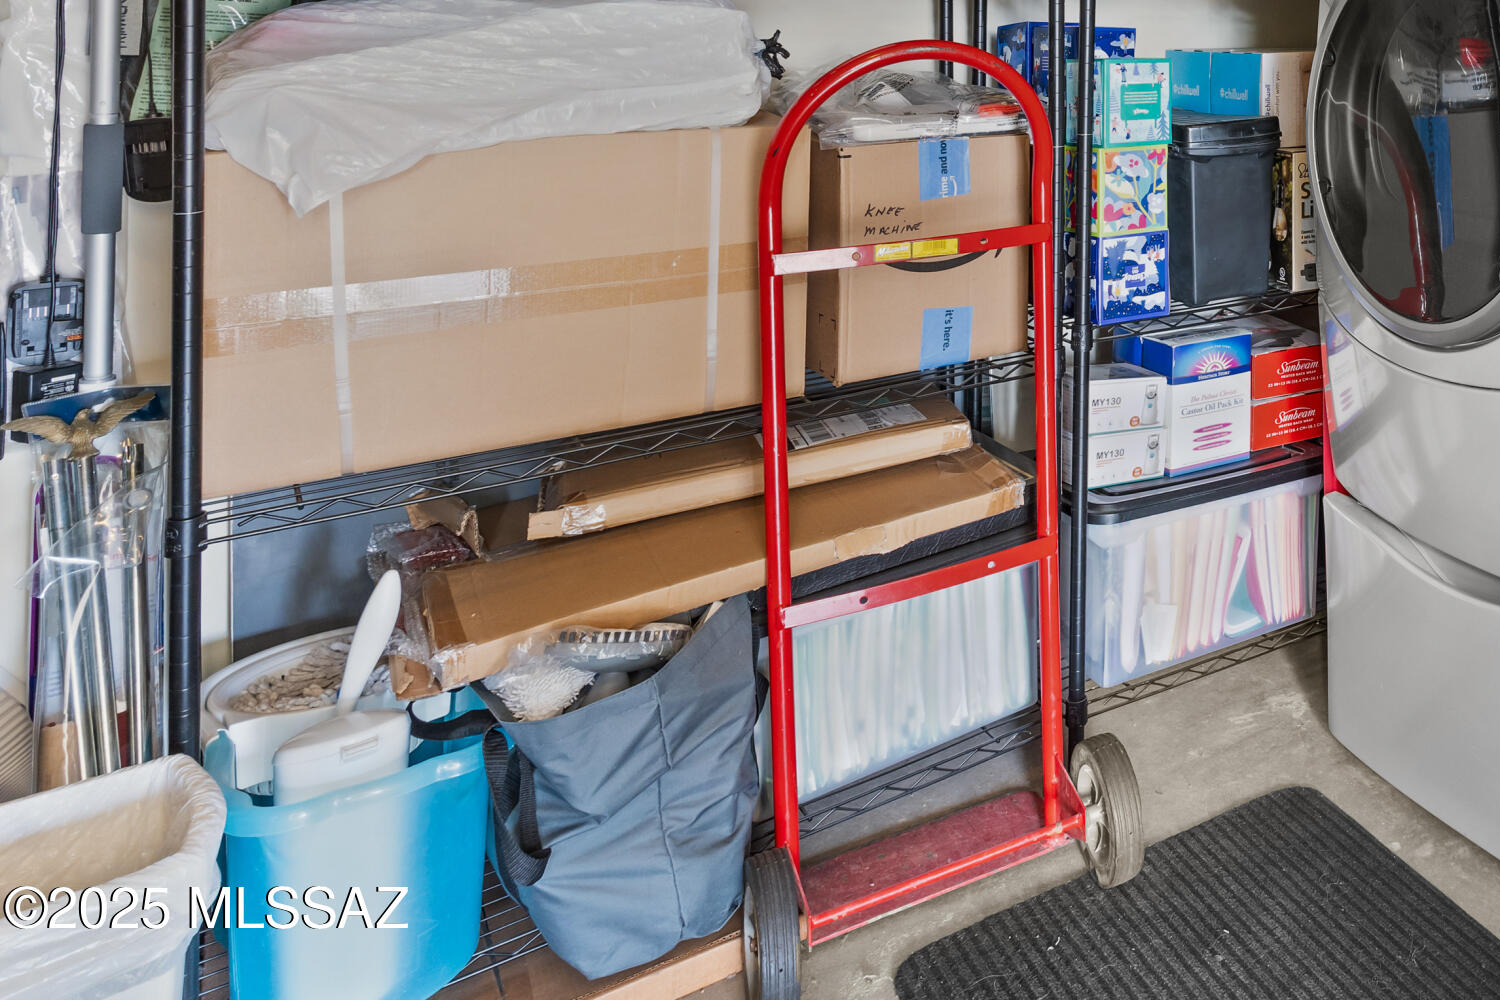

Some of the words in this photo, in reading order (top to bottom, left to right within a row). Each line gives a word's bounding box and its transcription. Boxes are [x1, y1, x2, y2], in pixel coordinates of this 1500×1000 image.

[939, 157, 948, 175] and
[939, 176, 948, 198] rime
[864, 203, 904, 217] KNEE
[944, 309, 955, 326] it's
[942, 327, 953, 351] here.
[1276, 360, 1319, 375] Sunbeam
[1091, 396, 1122, 408] MY130
[1274, 408, 1316, 425] Sunbeam
[1096, 449, 1125, 460] MY130
